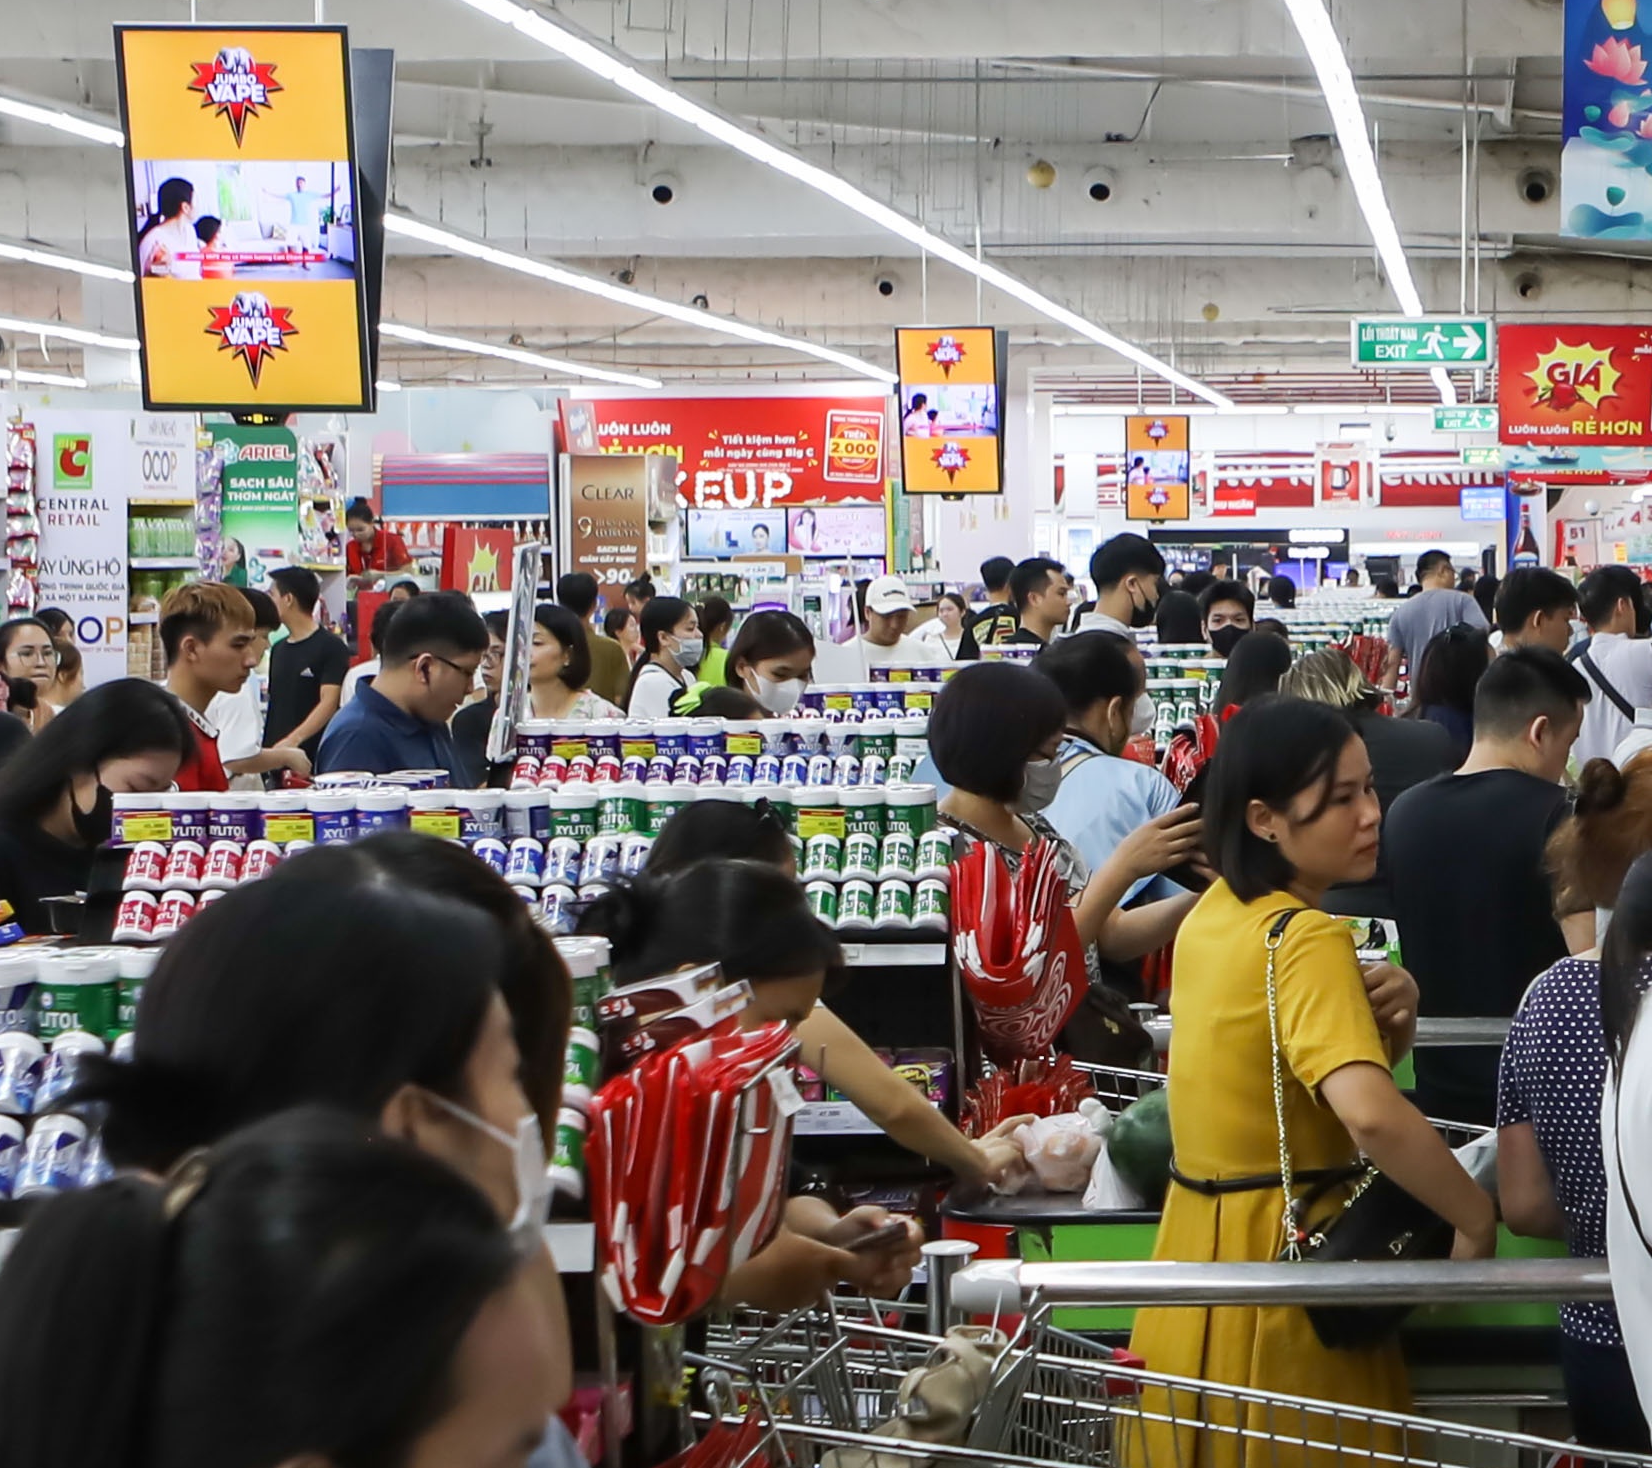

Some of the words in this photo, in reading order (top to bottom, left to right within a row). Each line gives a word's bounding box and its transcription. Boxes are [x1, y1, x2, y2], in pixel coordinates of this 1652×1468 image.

[215, 73, 257, 86] JUMBO
[206, 82, 266, 103] VAPE
[231, 317, 272, 328] JUMBO
[224, 328, 281, 346] VAPE
[1375, 345, 1408, 358] EXIT
[1547, 360, 1604, 392] GIÁ
[633, 423, 671, 436] LUÔN
[1508, 424, 1538, 435] LUÔN
[1540, 424, 1569, 435] LUÔN
[1572, 416, 1597, 436] RẺ
[1600, 419, 1642, 436] HƠN
[239, 445, 295, 461] ARIEL
[805, 447, 814, 458] C
[831, 440, 877, 456] 2.000
[268, 476, 294, 488] SÂU
[228, 490, 261, 502] THƠM
[581, 485, 634, 500] CLEAR
[37, 498, 110, 511] CENTRAL
[47, 513, 100, 527] RETAIL
[1570, 527, 1586, 539] 51
[555, 824, 594, 838] XYLITOL
